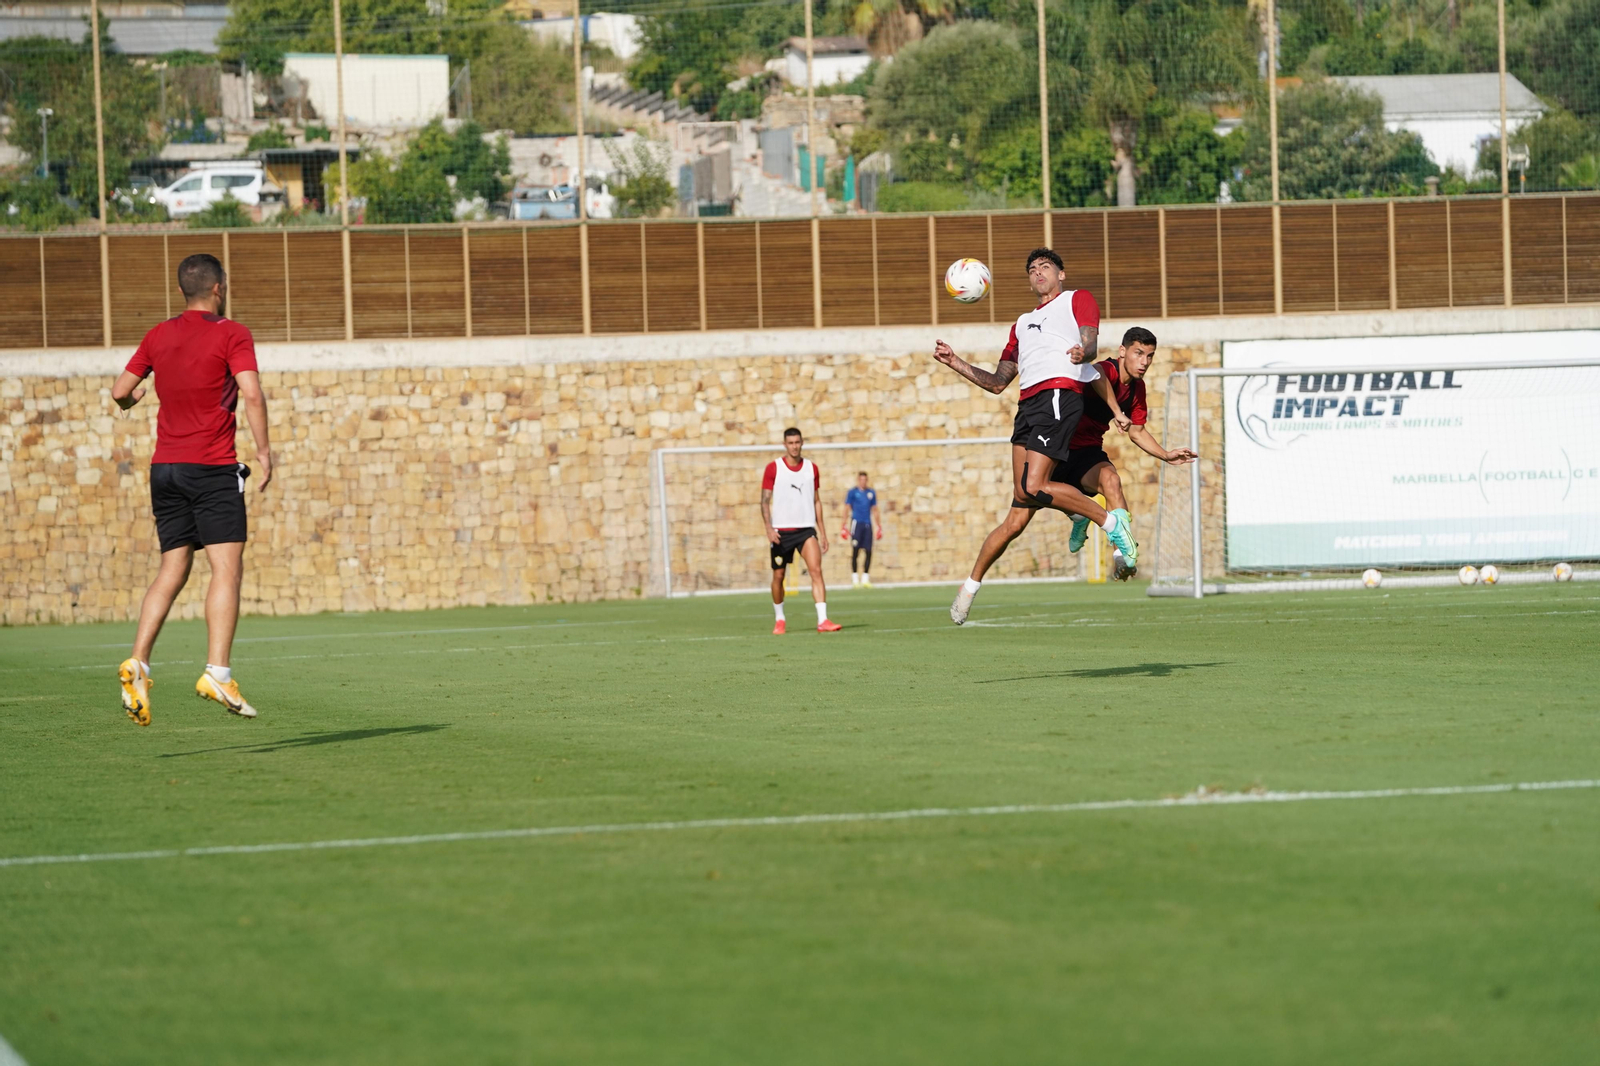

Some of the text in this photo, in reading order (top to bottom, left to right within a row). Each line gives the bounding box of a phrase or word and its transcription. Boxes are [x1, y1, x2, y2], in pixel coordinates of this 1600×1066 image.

[1276, 370, 1462, 393] FOOTBALL
[1272, 395, 1410, 419] IMPACT
[1402, 417, 1463, 428] MATCHES
[1392, 472, 1477, 484] MARBELLA
